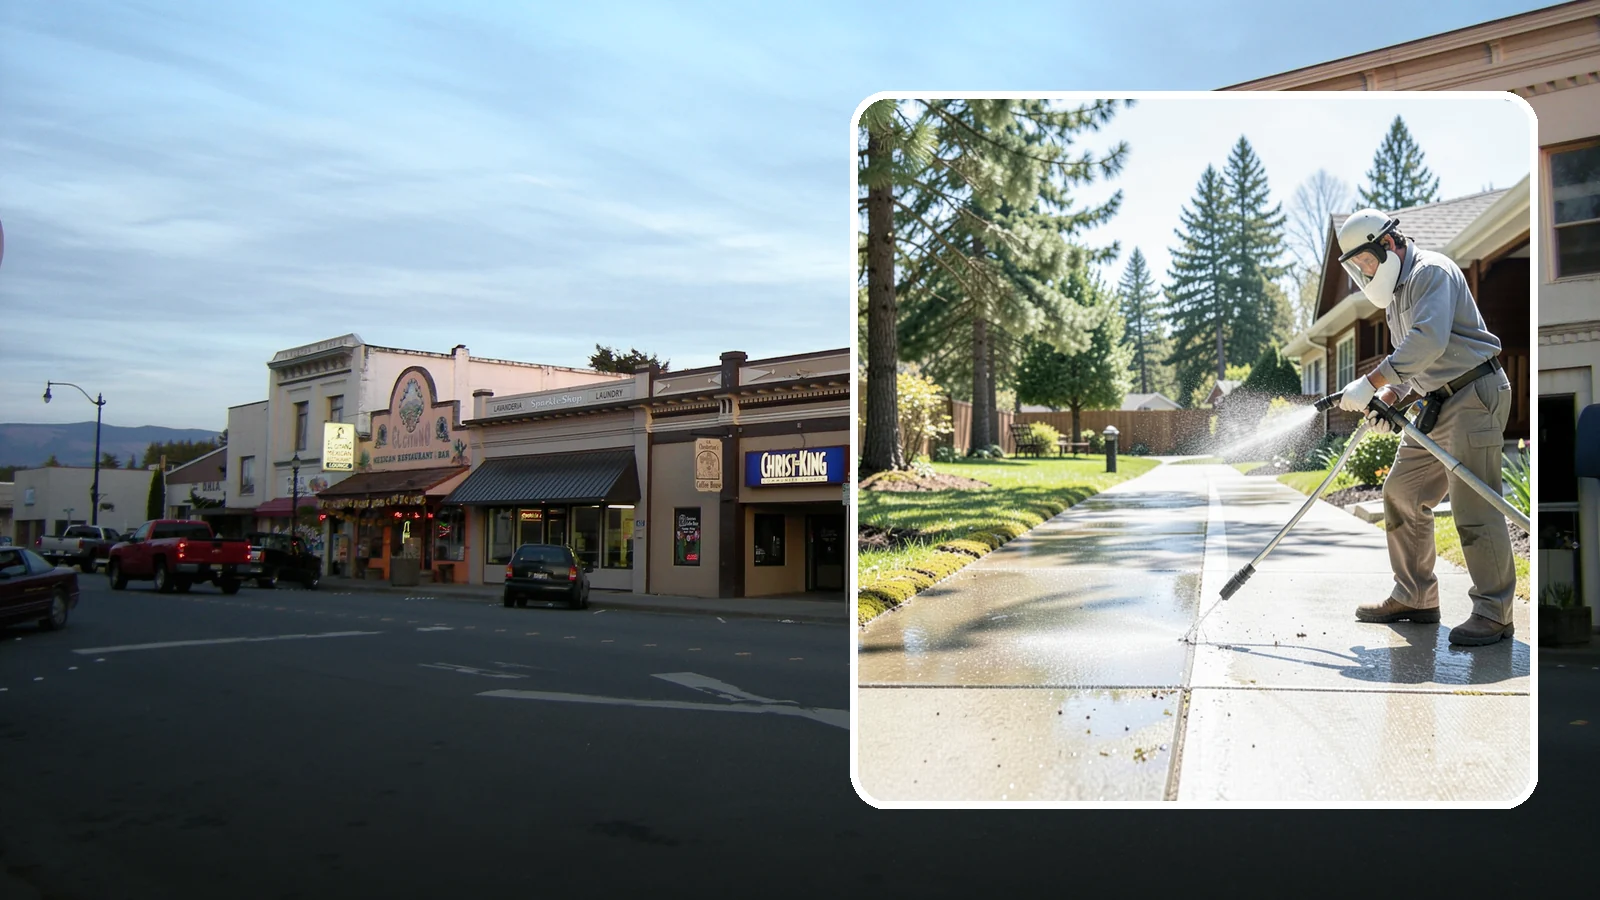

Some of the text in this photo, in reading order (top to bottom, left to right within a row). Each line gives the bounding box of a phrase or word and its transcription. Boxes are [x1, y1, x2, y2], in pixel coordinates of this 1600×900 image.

[595, 388, 623, 400] LAUNDRY
[493, 402, 523, 413] LAVANDERIA
[530, 394, 582, 409] Sparkle Shop
[373, 455, 396, 465] MEXICAN
[397, 452, 433, 462] RESTAURANT
[438, 450, 450, 460] BAR
